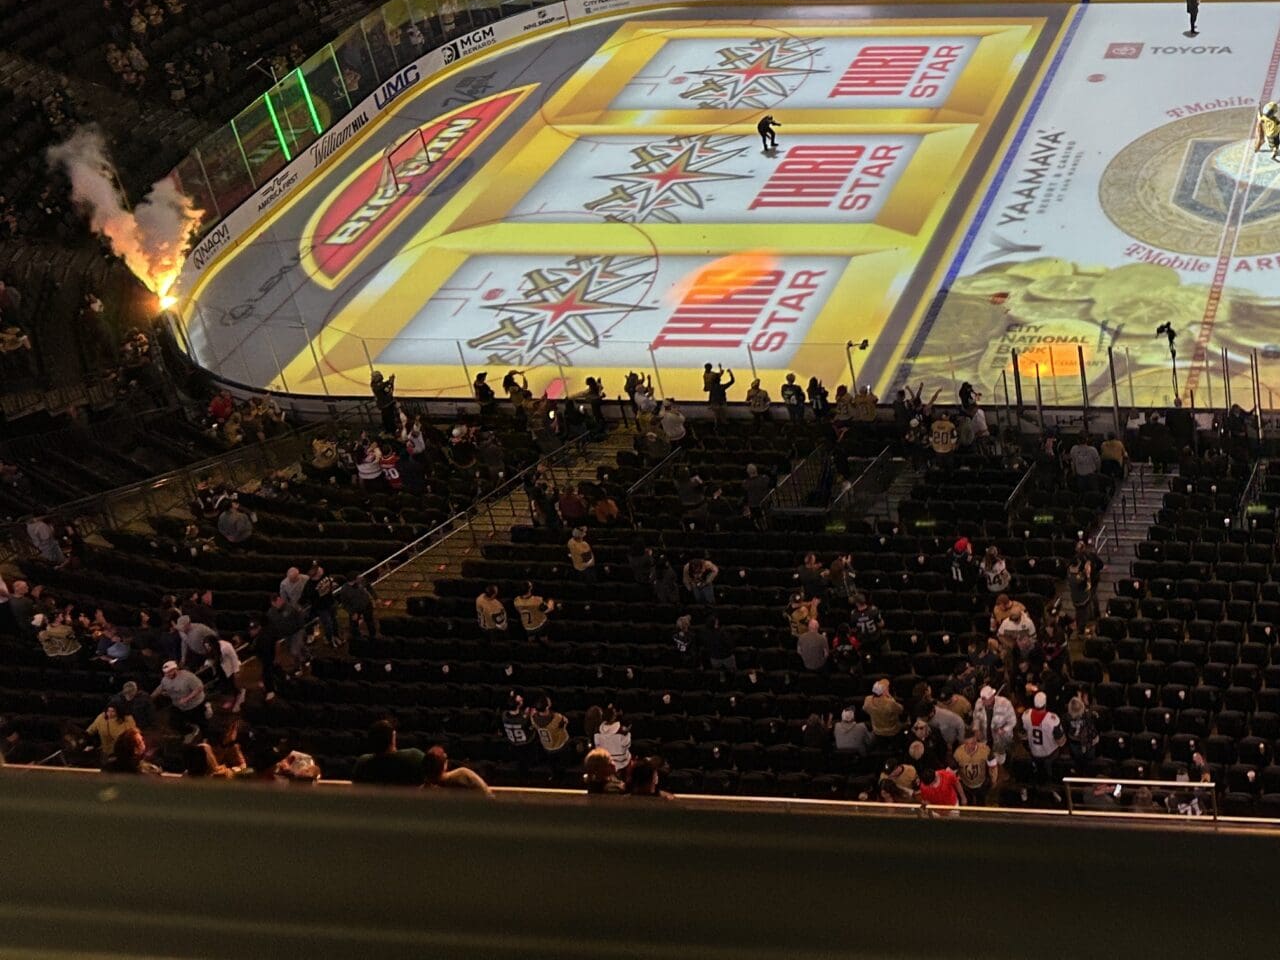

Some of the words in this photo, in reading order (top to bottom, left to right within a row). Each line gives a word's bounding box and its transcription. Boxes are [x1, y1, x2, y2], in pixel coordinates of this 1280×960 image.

[460, 26, 495, 50] MGM
[462, 37, 498, 58] REWARDS
[1150, 45, 1233, 55] TOYOTA
[373, 63, 421, 111] UMC
[828, 45, 930, 98] THIRD
[909, 44, 965, 98] STAR
[1183, 95, 1255, 115] Mobile
[748, 144, 866, 211] THIRD
[837, 144, 904, 211] STAR
[652, 269, 786, 351] THIRD
[751, 269, 828, 352] STAR
[1000, 334, 1089, 344] NATIONAL
[1033, 728, 1043, 746] 9
